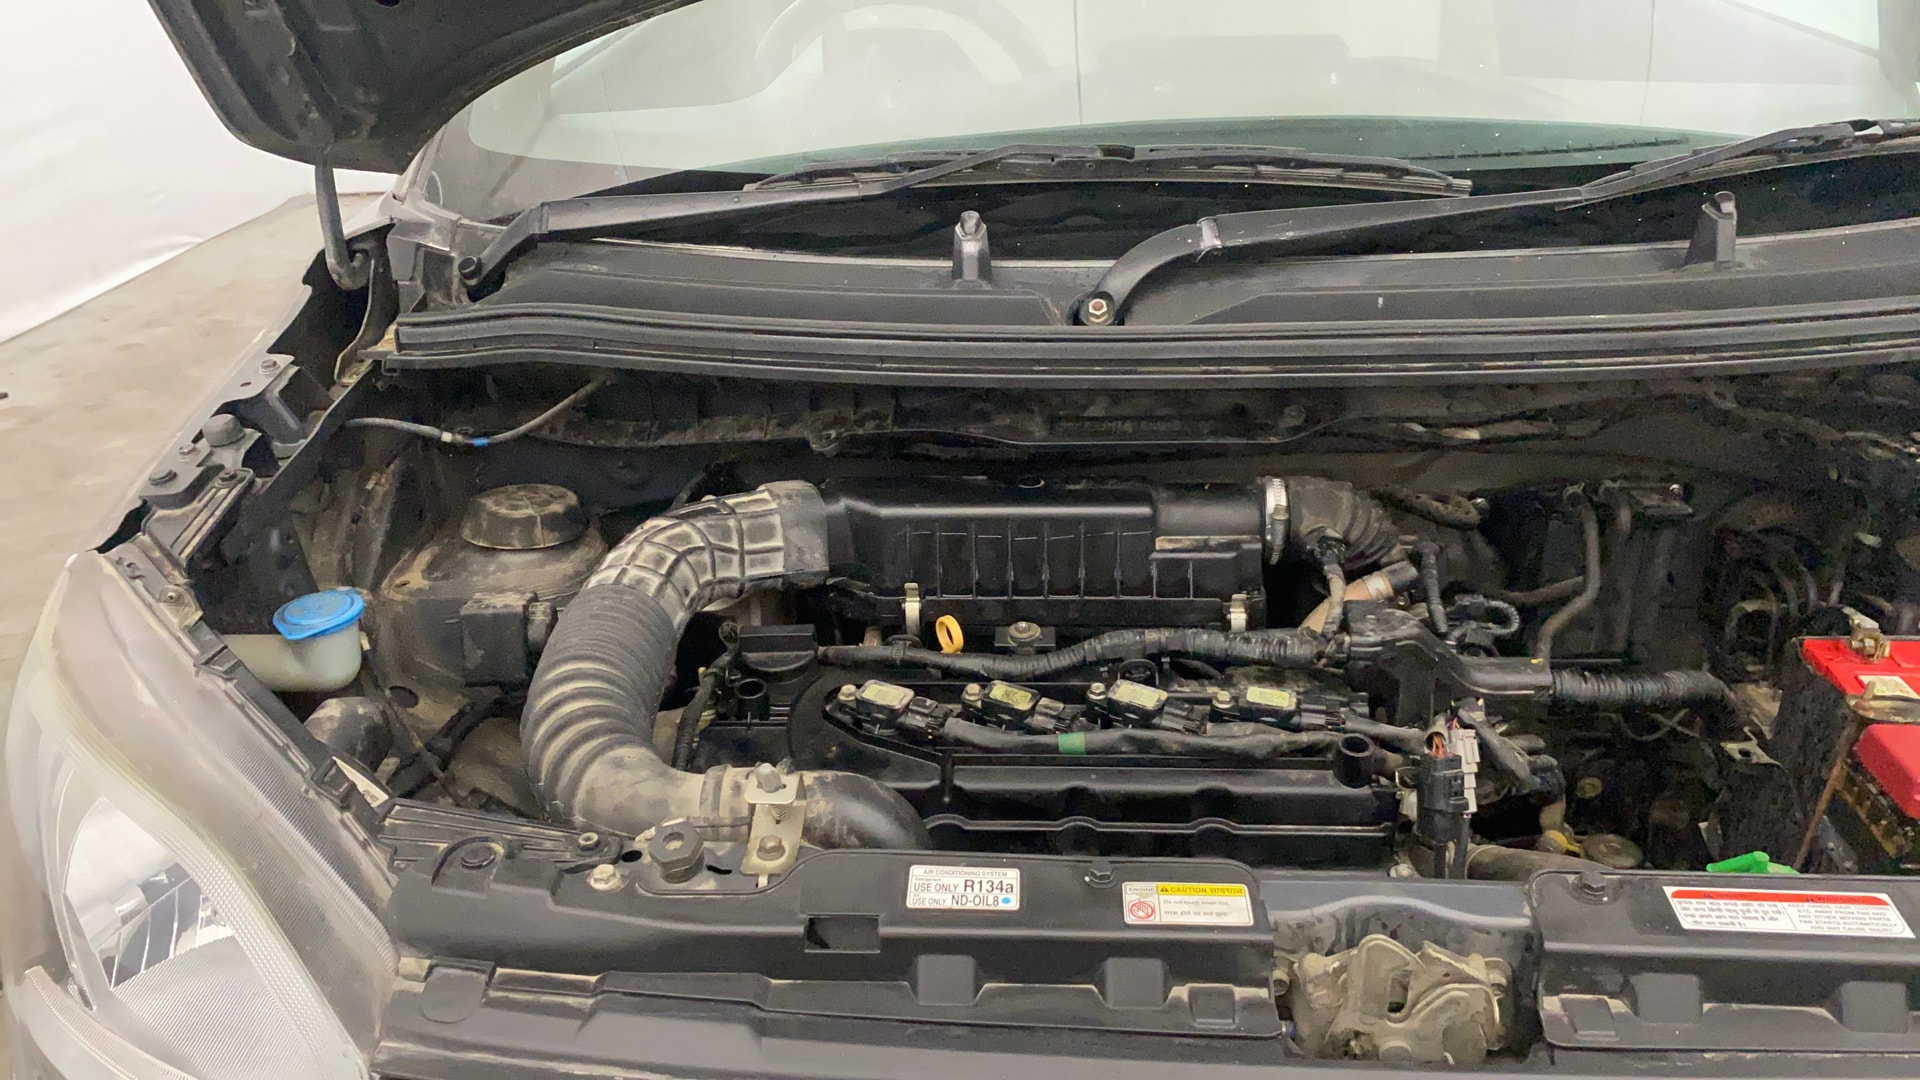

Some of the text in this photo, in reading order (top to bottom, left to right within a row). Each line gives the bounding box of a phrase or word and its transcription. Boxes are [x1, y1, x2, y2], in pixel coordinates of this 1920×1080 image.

[914, 879, 1014, 893] USE ONLY R134a
[912, 894, 999, 907] USE ONLY ND-OIL8
